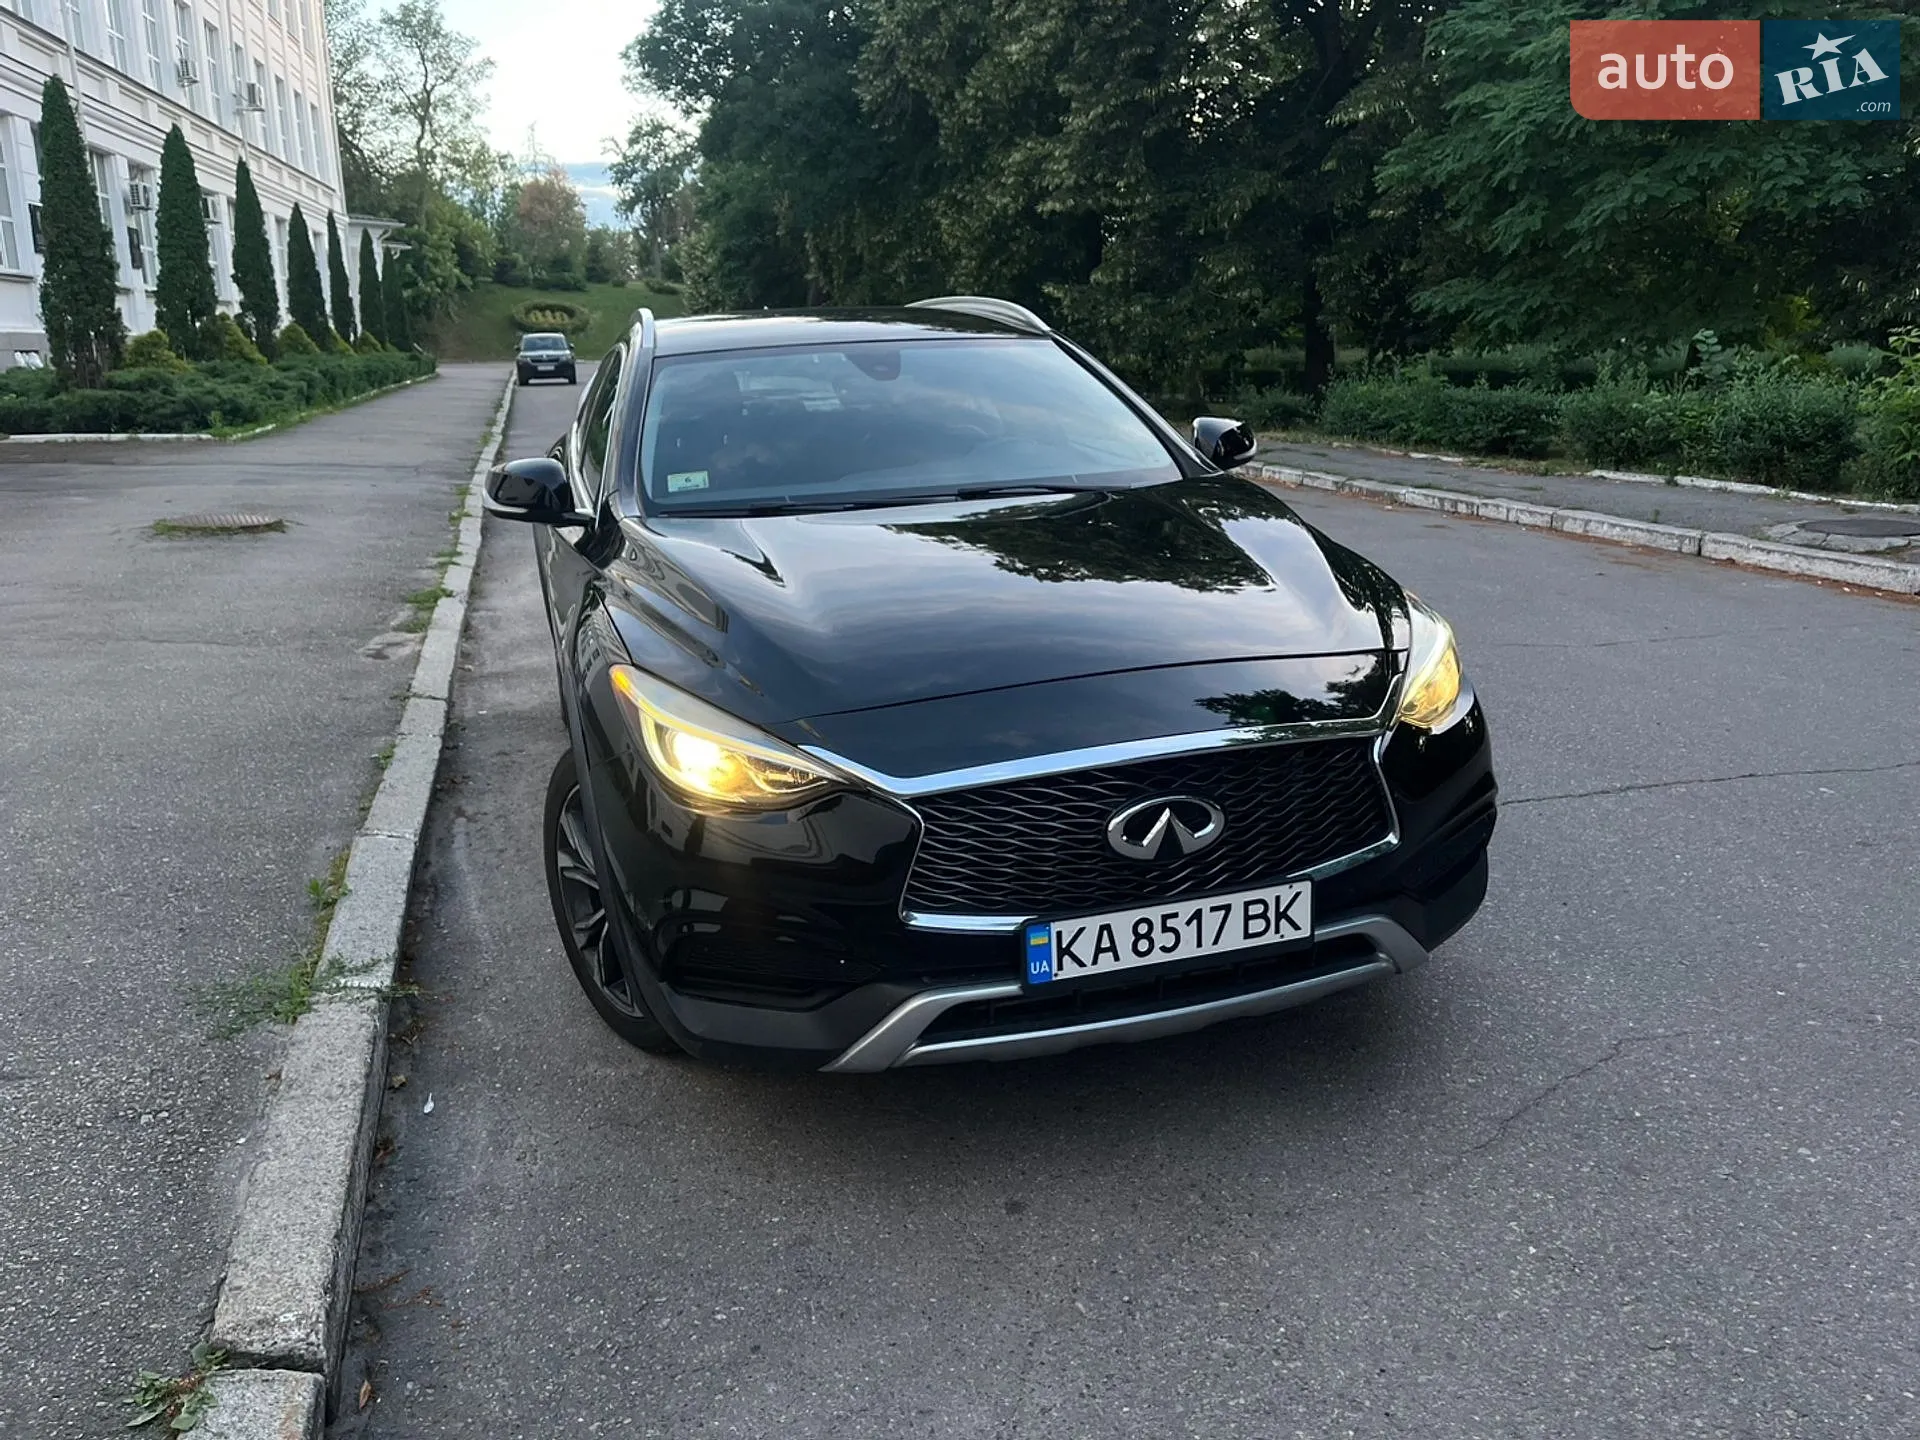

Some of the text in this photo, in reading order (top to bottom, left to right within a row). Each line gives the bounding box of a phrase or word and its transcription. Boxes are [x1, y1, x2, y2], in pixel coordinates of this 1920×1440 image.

[1056, 891, 1303, 972] KA 8517 BK
[1030, 961, 1050, 975] UA
